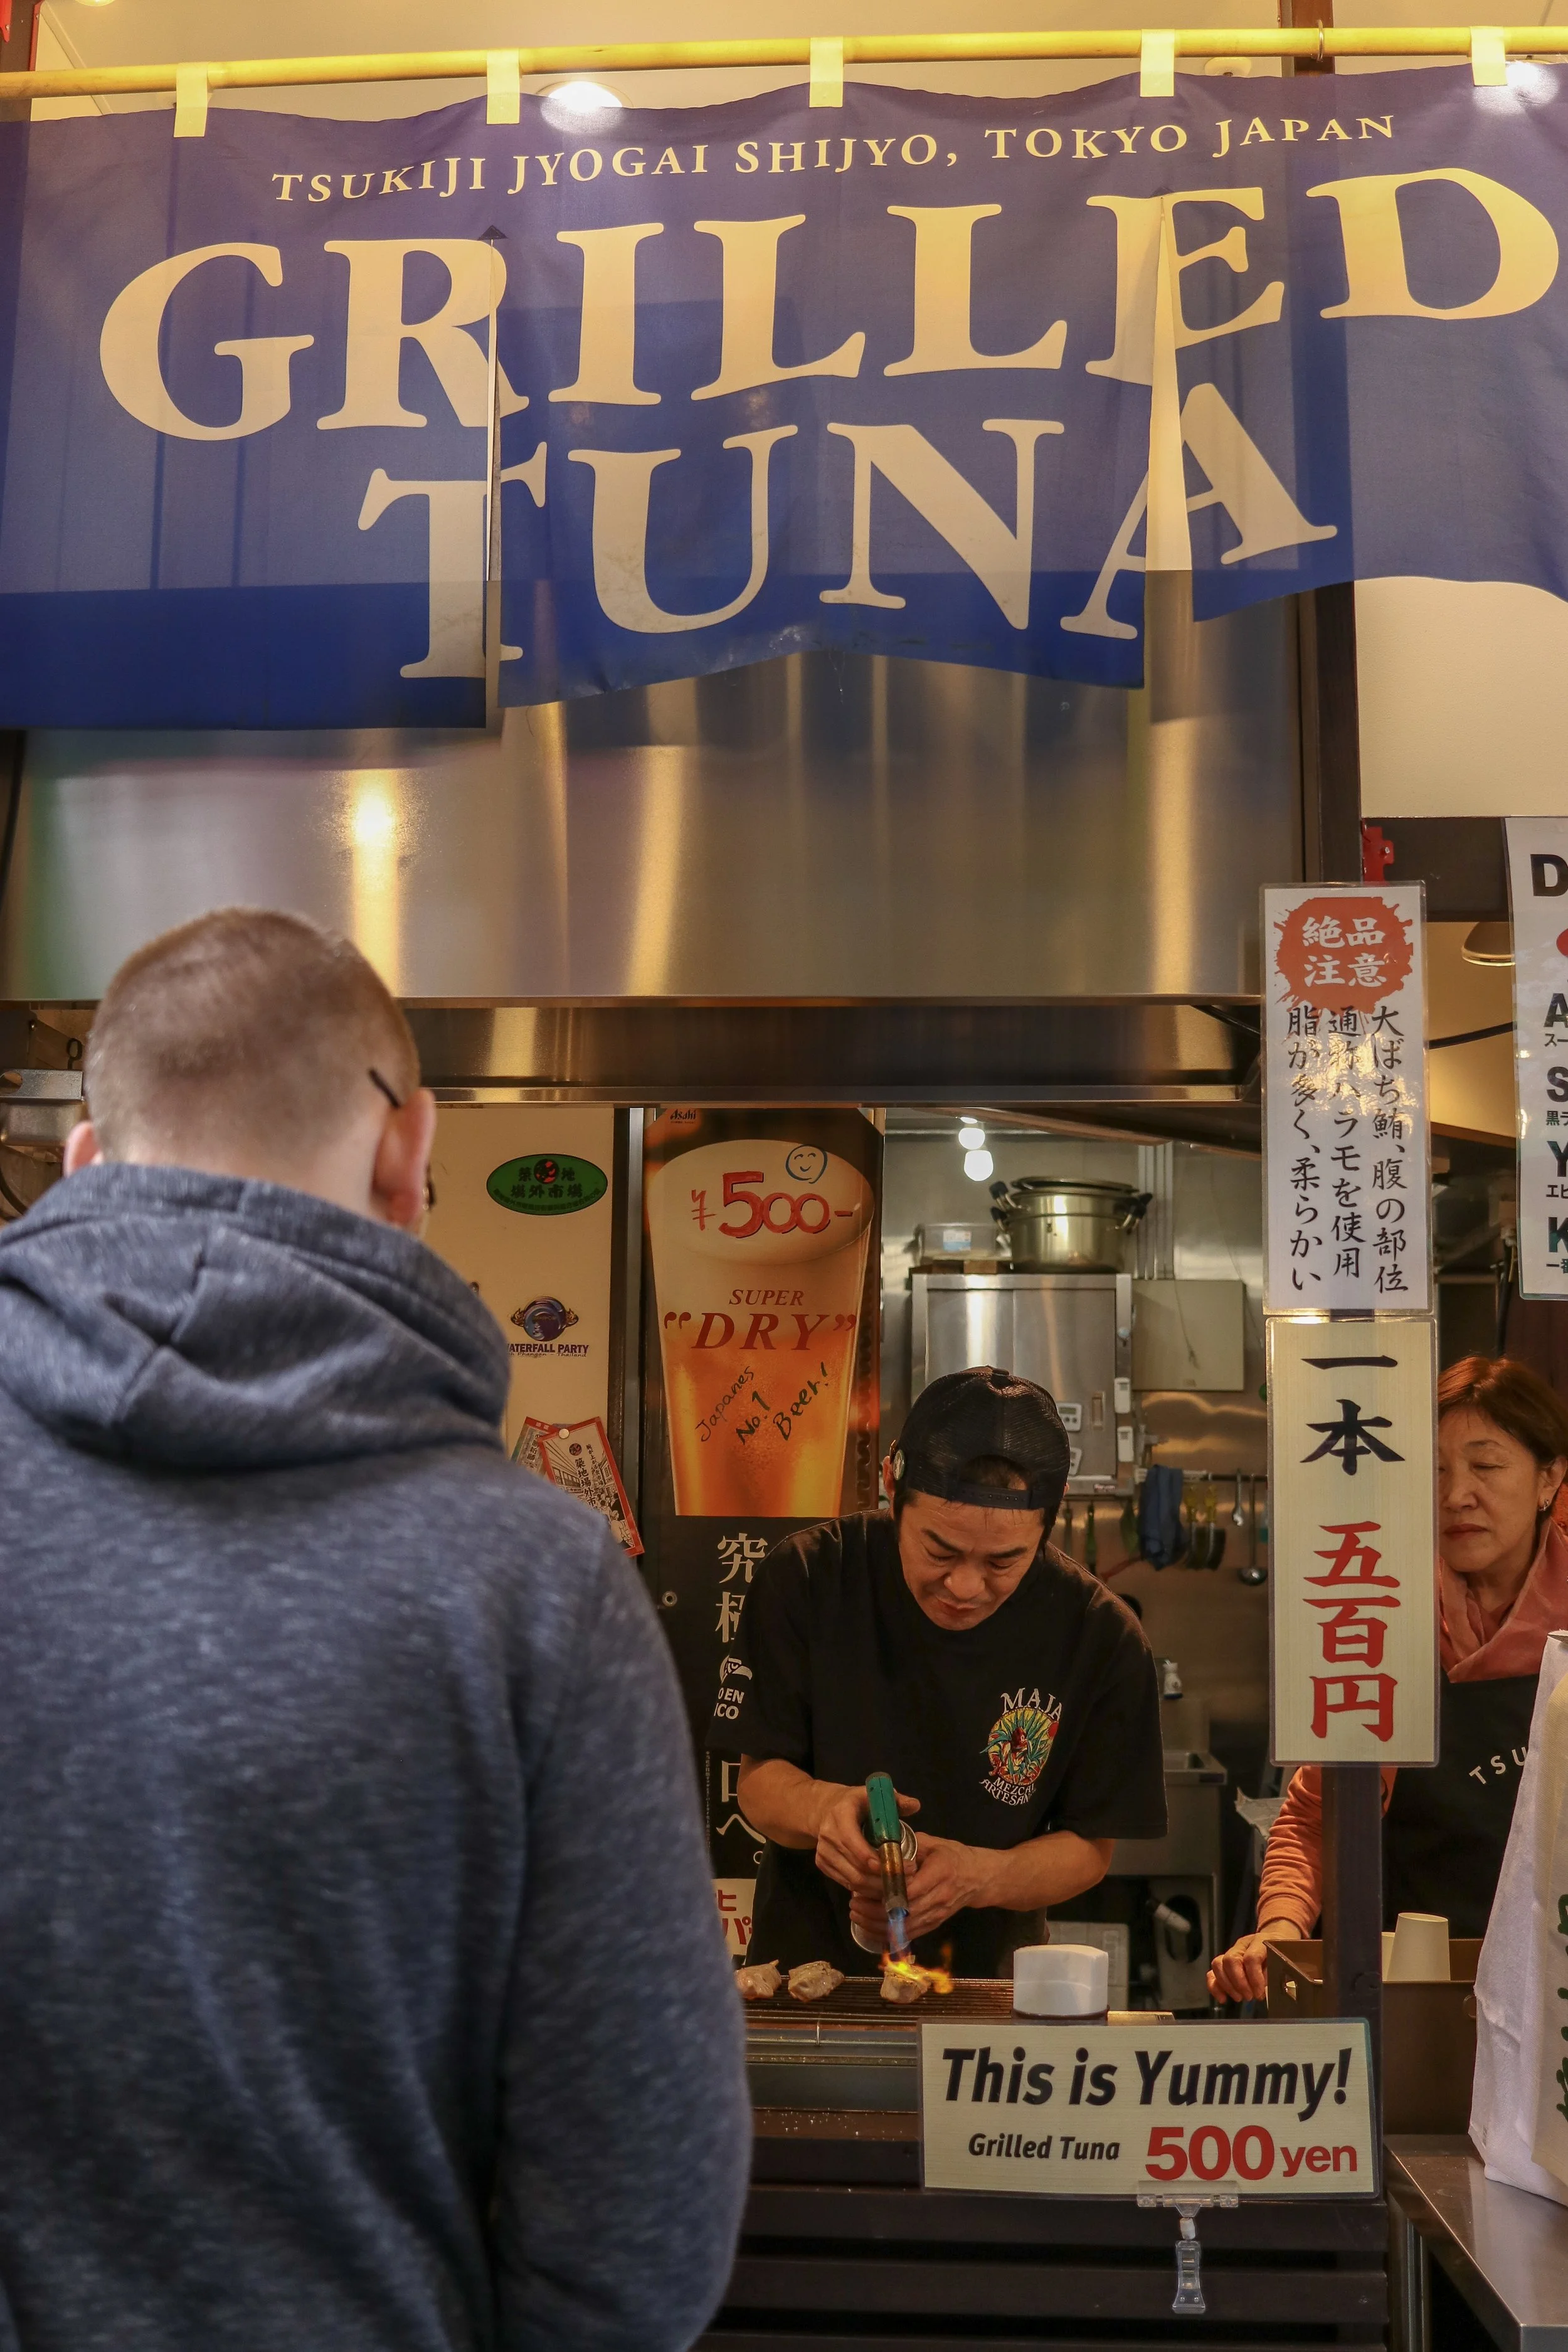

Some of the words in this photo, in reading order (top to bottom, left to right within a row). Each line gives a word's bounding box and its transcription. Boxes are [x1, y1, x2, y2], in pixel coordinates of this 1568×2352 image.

[272, 157, 486, 202] TSUKIJI
[508, 144, 706, 196] JYOGAI
[736, 134, 958, 175] SHIJYO,
[985, 125, 1188, 161] TOKYO
[1213, 115, 1395, 159] JAPAN
[99, 167, 1559, 443] GRILLED
[357, 383, 1338, 679] TUNA
[1301, 916, 1384, 949] 絶品
[1304, 953, 1386, 988] 注意
[670, 1108, 697, 1120] Asahi
[1287, 1005, 1322, 1291] 脂が多く、柔らかい
[729, 1289, 805, 1306] SUPER
[558, 1343, 589, 1353] PARTY
[773, 1361, 829, 1441] Beer!
[1300, 1355, 1406, 1476] 一本
[575, 1458, 597, 1509] 築地場外市
[1302, 1521, 1401, 1742] 五百円
[724, 1688, 744, 1703] EN
[943, 2047, 1054, 2106] This
[1069, 2047, 1117, 2106] is
[1135, 2048, 1352, 2122] Yummy!
[968, 2133, 1052, 2159] Grilled
[1060, 2137, 1120, 2159] Tuna
[1145, 2126, 1274, 2180] 500
[1280, 2145, 1358, 2177] yen
